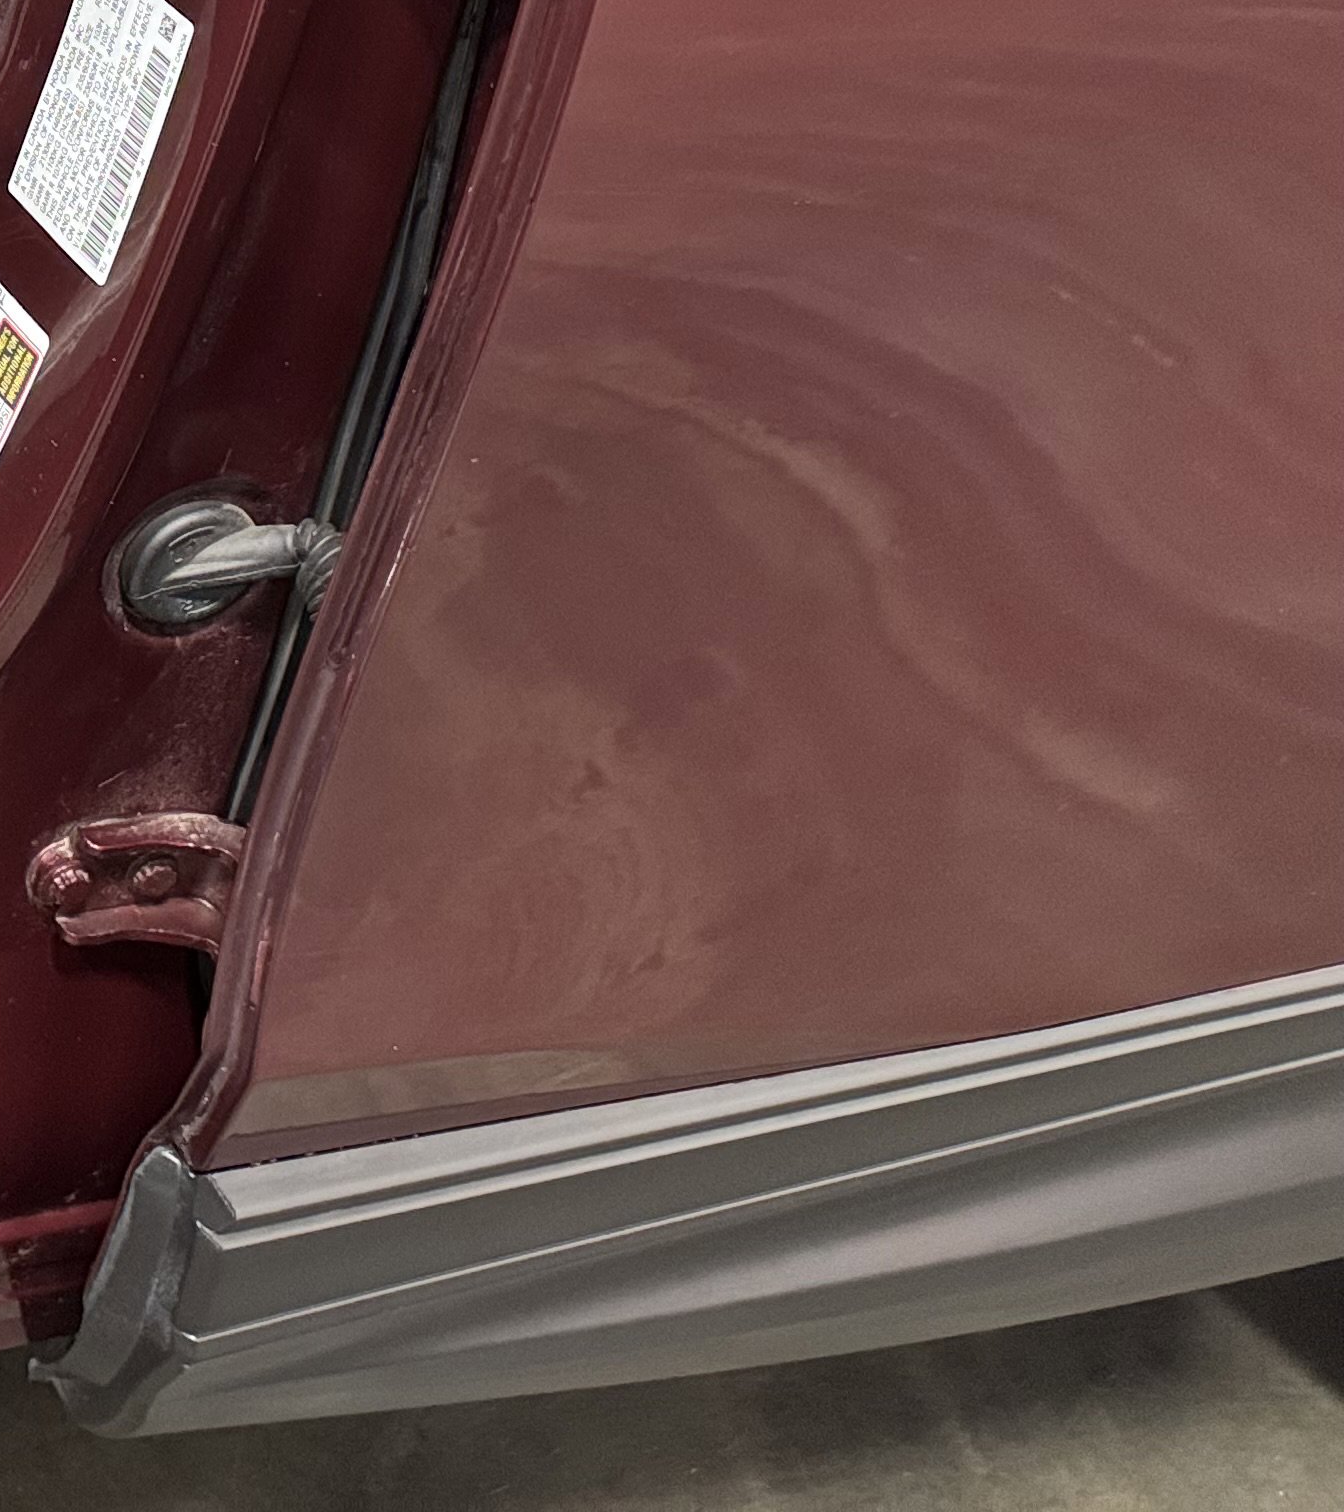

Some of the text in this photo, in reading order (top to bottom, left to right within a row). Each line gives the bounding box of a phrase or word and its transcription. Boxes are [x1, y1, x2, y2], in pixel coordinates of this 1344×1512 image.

[73, 47, 85, 72] TIRE
[81, 22, 94, 46] SIZE
[120, 92, 133, 120] TYPE
[130, 66, 142, 91] MPV
[24, 140, 42, 183] DIVISION
[45, 86, 62, 123] HONDA
[59, 43, 77, 85] CANADA
[27, 106, 45, 147] CANADA
[48, 51, 65, 88] HONDA
[52, 62, 116, 229] FEDERAL MOTOR VEHICLE SAFETY
[55, 154, 73, 196] VEHICLE
[71, 97, 94, 154] CONFORMS
[59, 211, 71, 236] AND
[68, 178, 83, 211] THEFT
[80, 115, 106, 178] PREVENTION
[103, 53, 128, 114] STANDARDS
[81, 172, 95, 201] DATE
[98, 80, 128, 154] MANUFACTURE
[124, 39, 142, 79] SHOWN
[137, 1, 154, 38] ABOVE
[5, 350, 34, 405] INFORMATION
[6, 334, 19, 354] FOR
